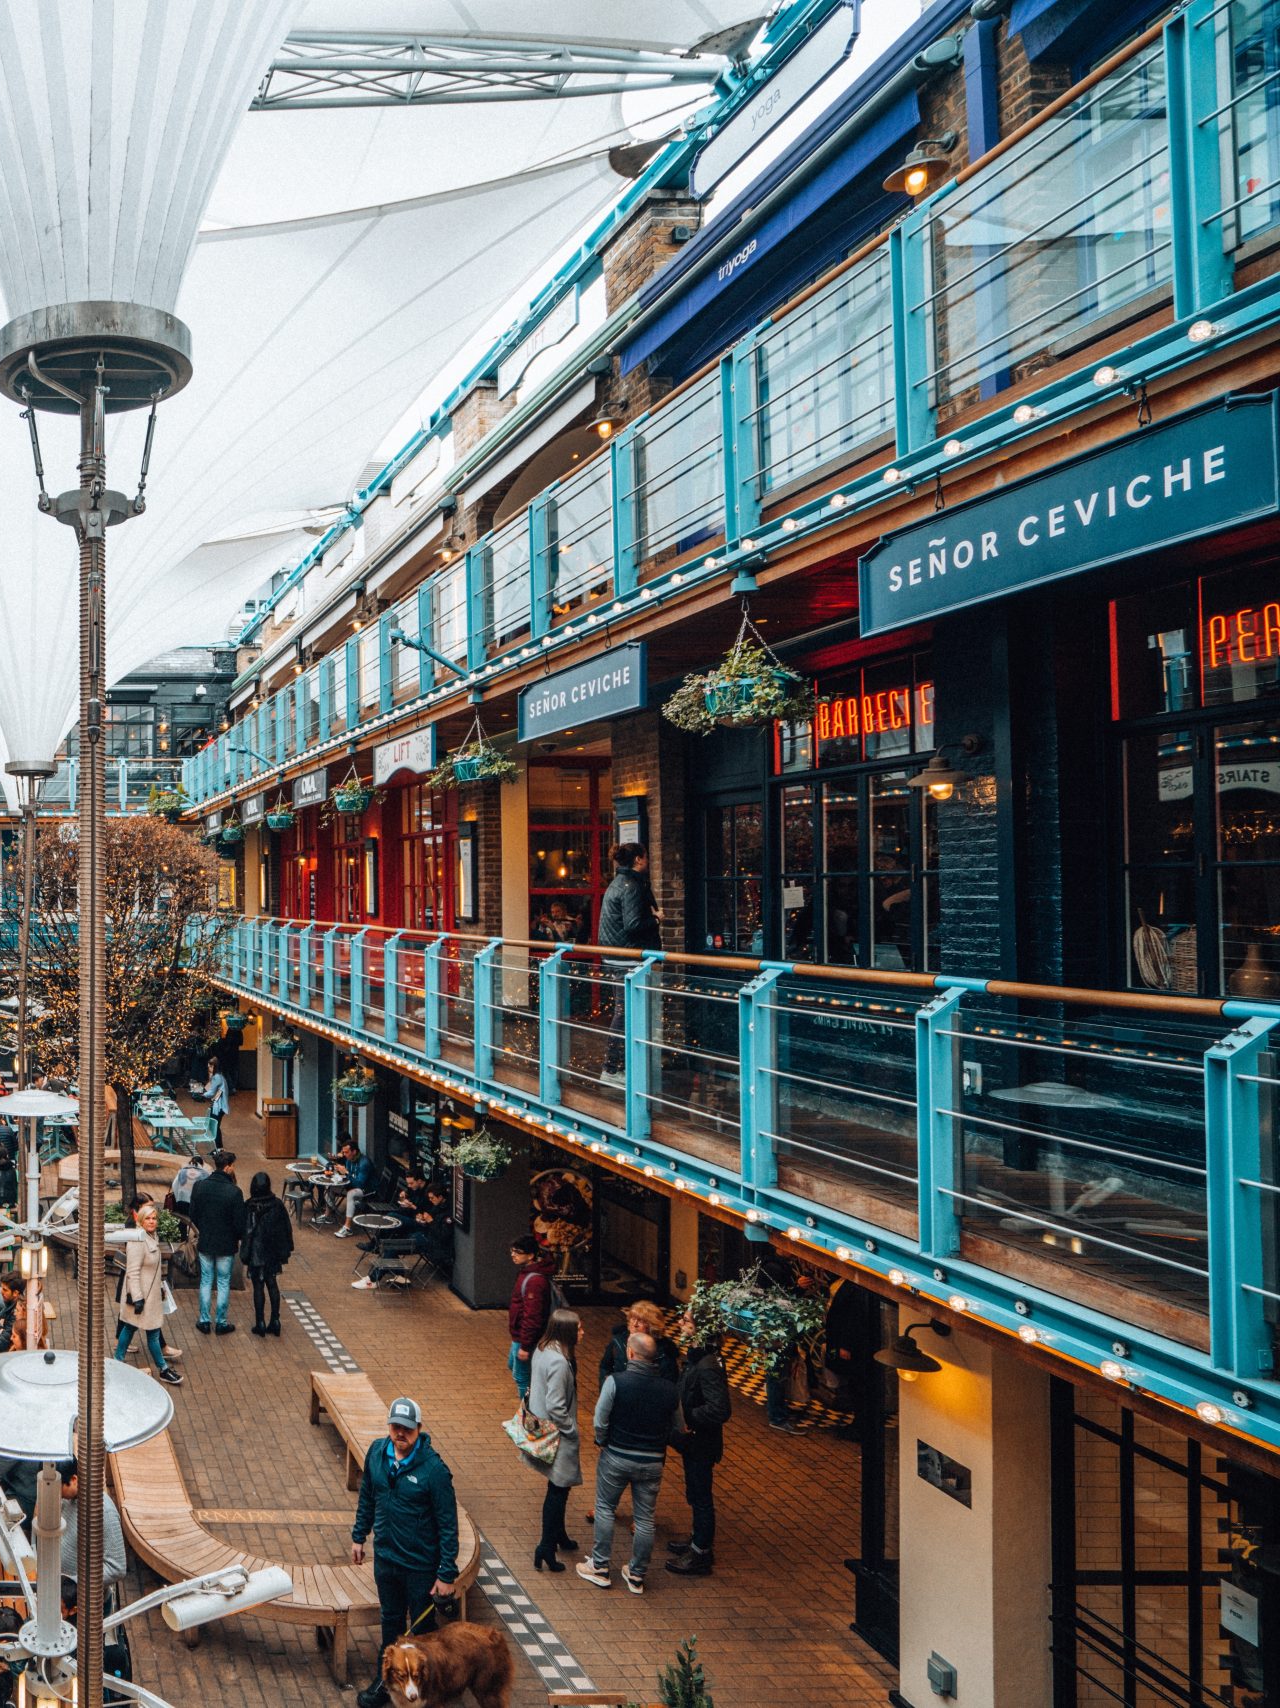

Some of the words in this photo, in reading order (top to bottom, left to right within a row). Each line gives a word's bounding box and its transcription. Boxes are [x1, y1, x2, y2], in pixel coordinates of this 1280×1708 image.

[718, 239, 757, 282] triyoga
[888, 531, 999, 592] SEÑOR
[1017, 445, 1226, 547] CEVICHE
[529, 690, 567, 718] SEÑOR
[571, 666, 630, 703] CEVICHE
[393, 740, 411, 763] LIFT
